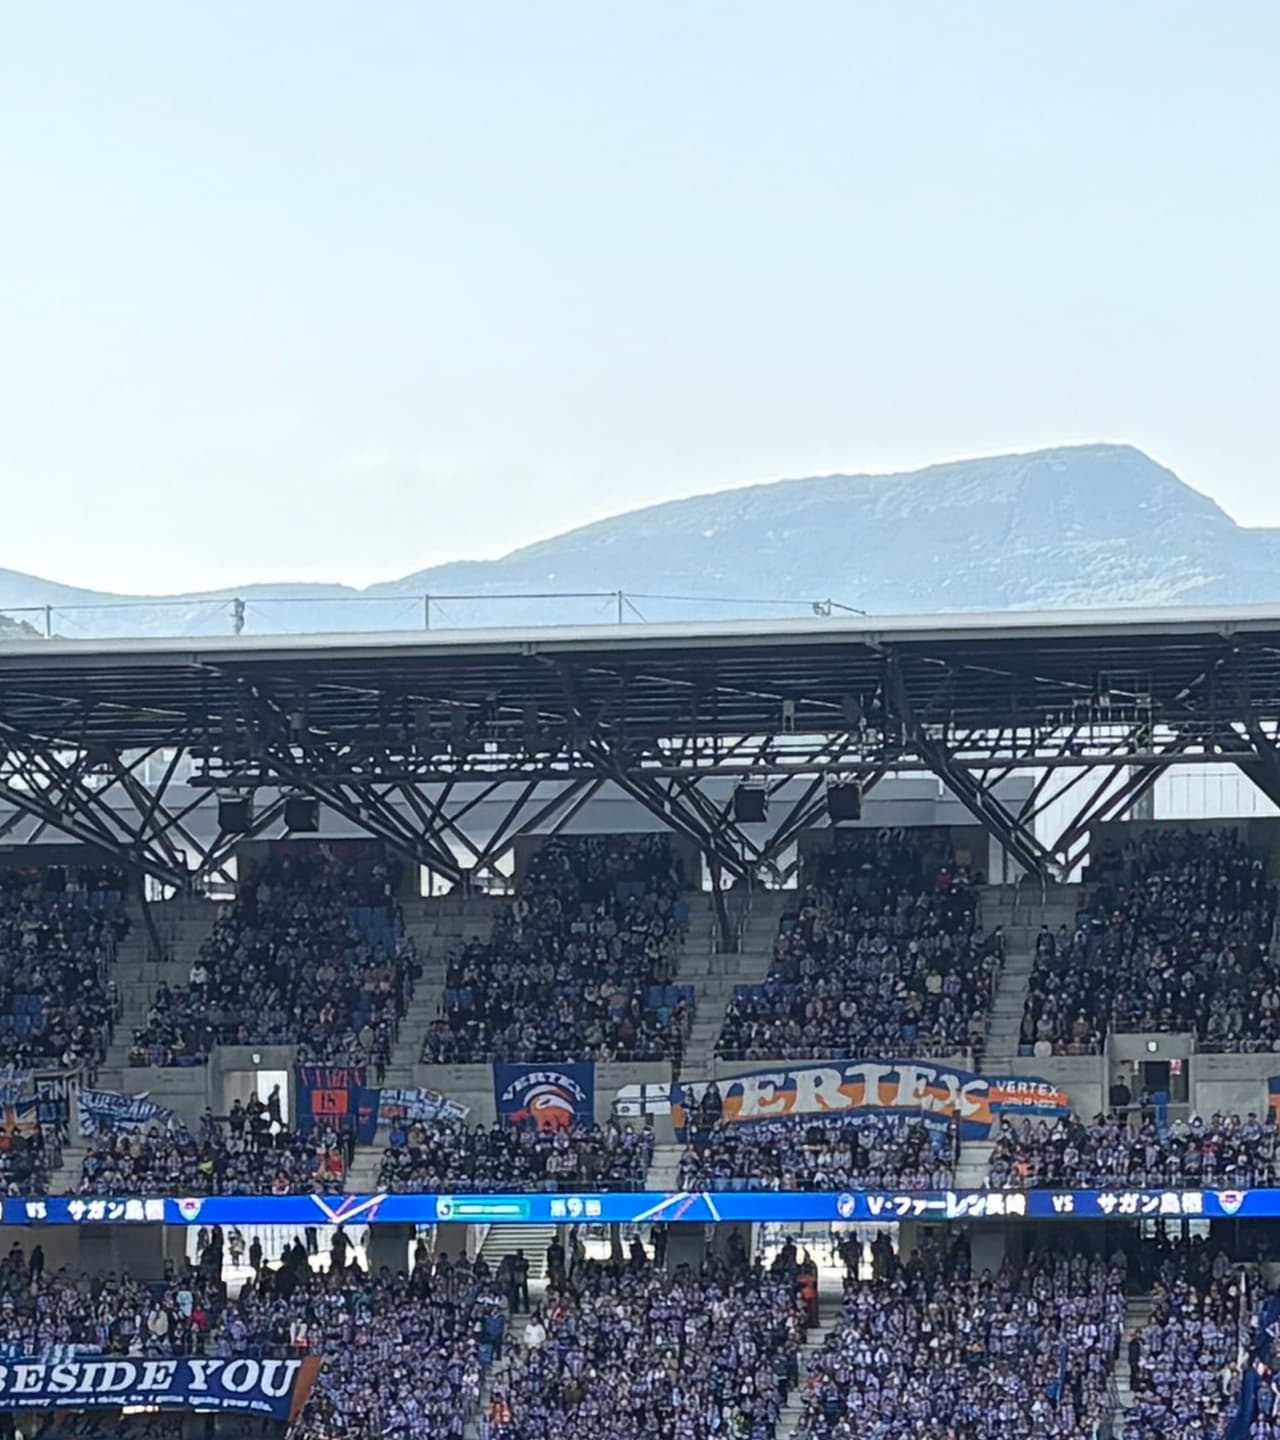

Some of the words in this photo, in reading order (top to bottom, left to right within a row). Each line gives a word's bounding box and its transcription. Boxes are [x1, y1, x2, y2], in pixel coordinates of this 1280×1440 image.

[502, 1071, 587, 1101] VERTEX
[996, 1080, 1059, 1098] VERTEX
[25, 1202, 47, 1219] VS
[1052, 1196, 1074, 1213] VS
[179, 1358, 303, 1398] YOU
